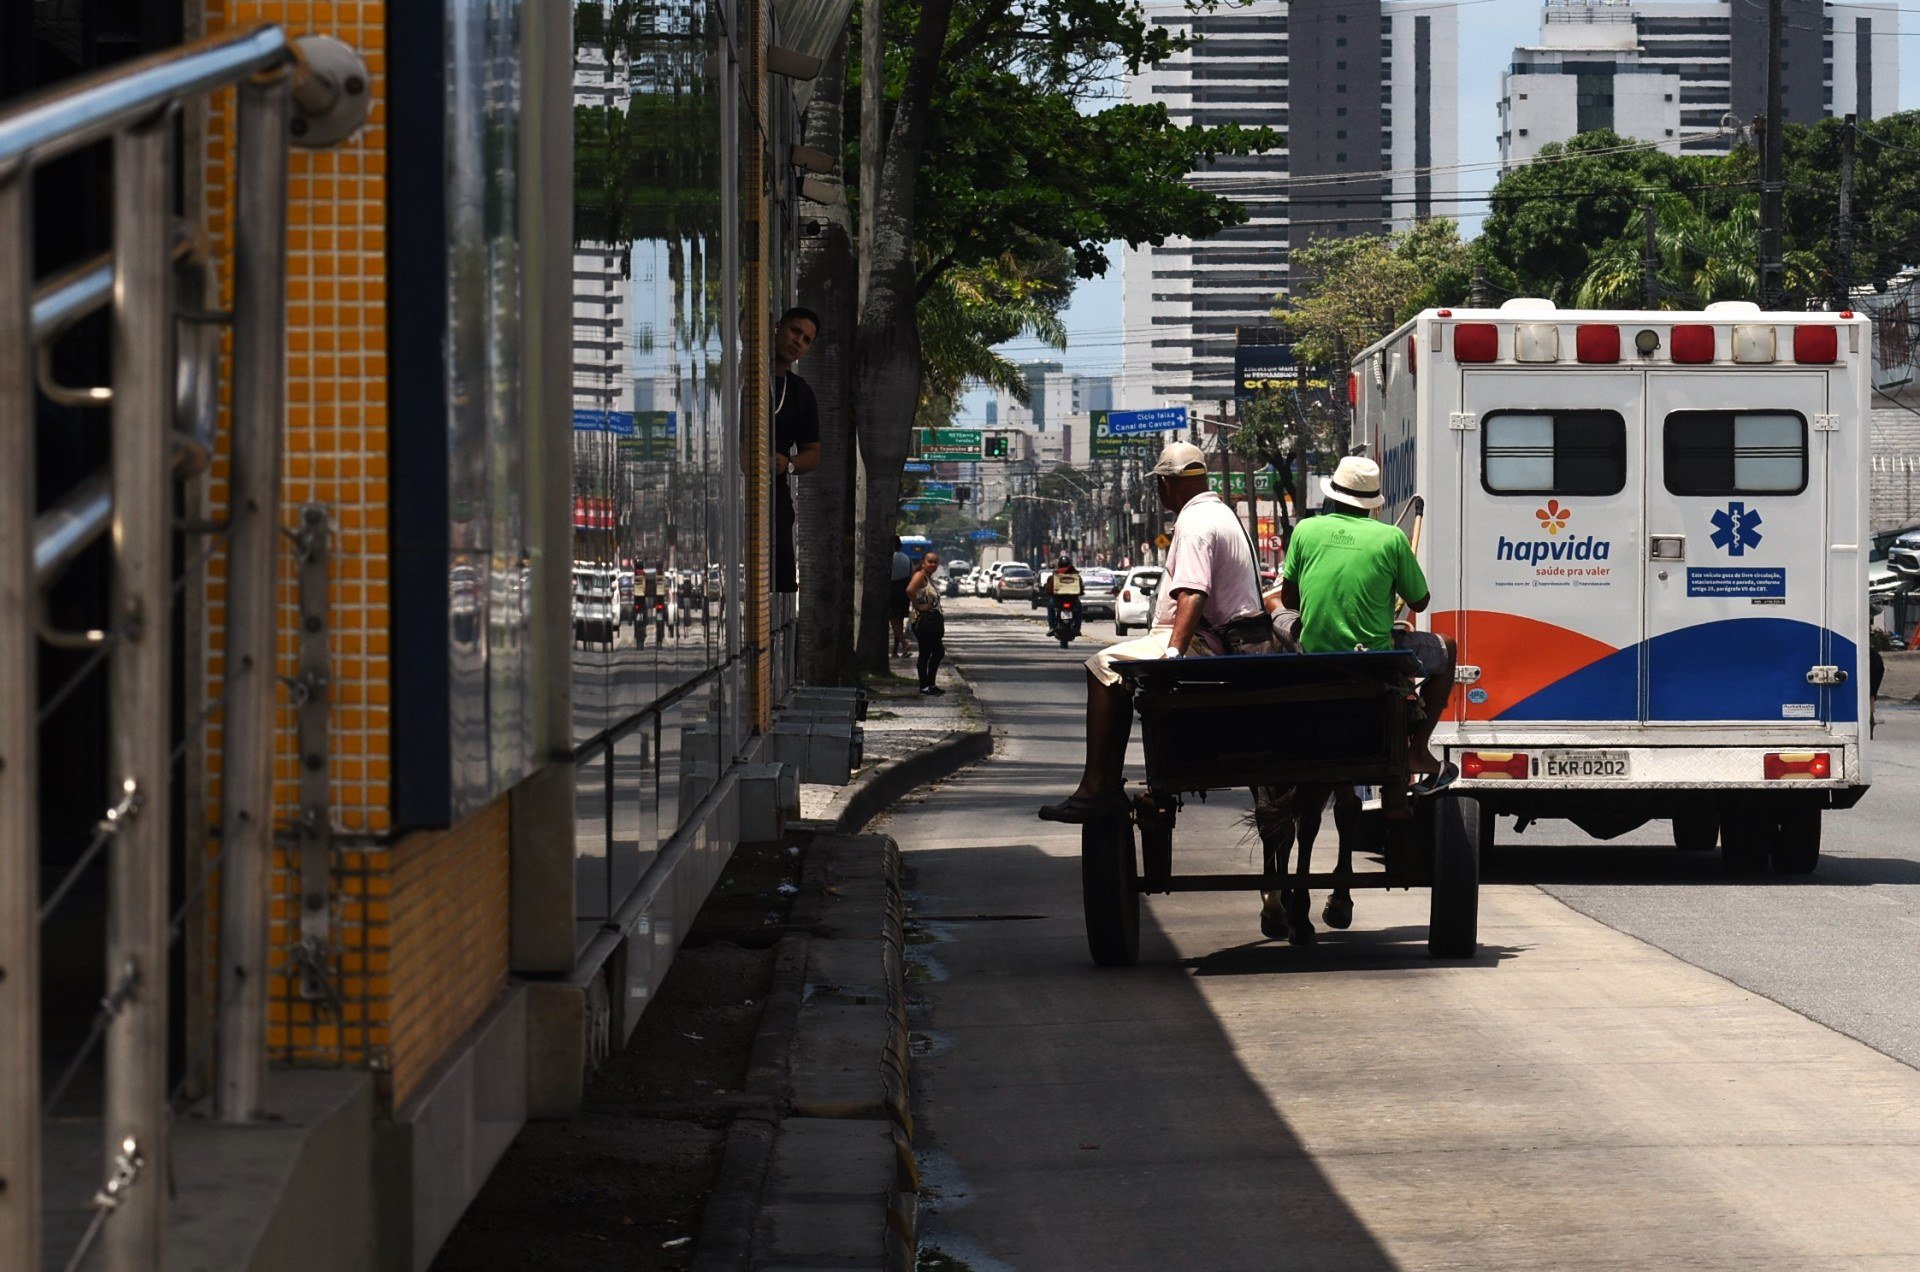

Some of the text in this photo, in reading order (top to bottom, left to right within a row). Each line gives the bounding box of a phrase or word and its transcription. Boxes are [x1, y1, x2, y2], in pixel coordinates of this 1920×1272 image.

[1137, 412, 1155, 420] Ciclo
[1115, 422, 1136, 431] Canal
[1497, 534, 1611, 567] hapvida
[1536, 566, 1611, 577] saúde pra valer
